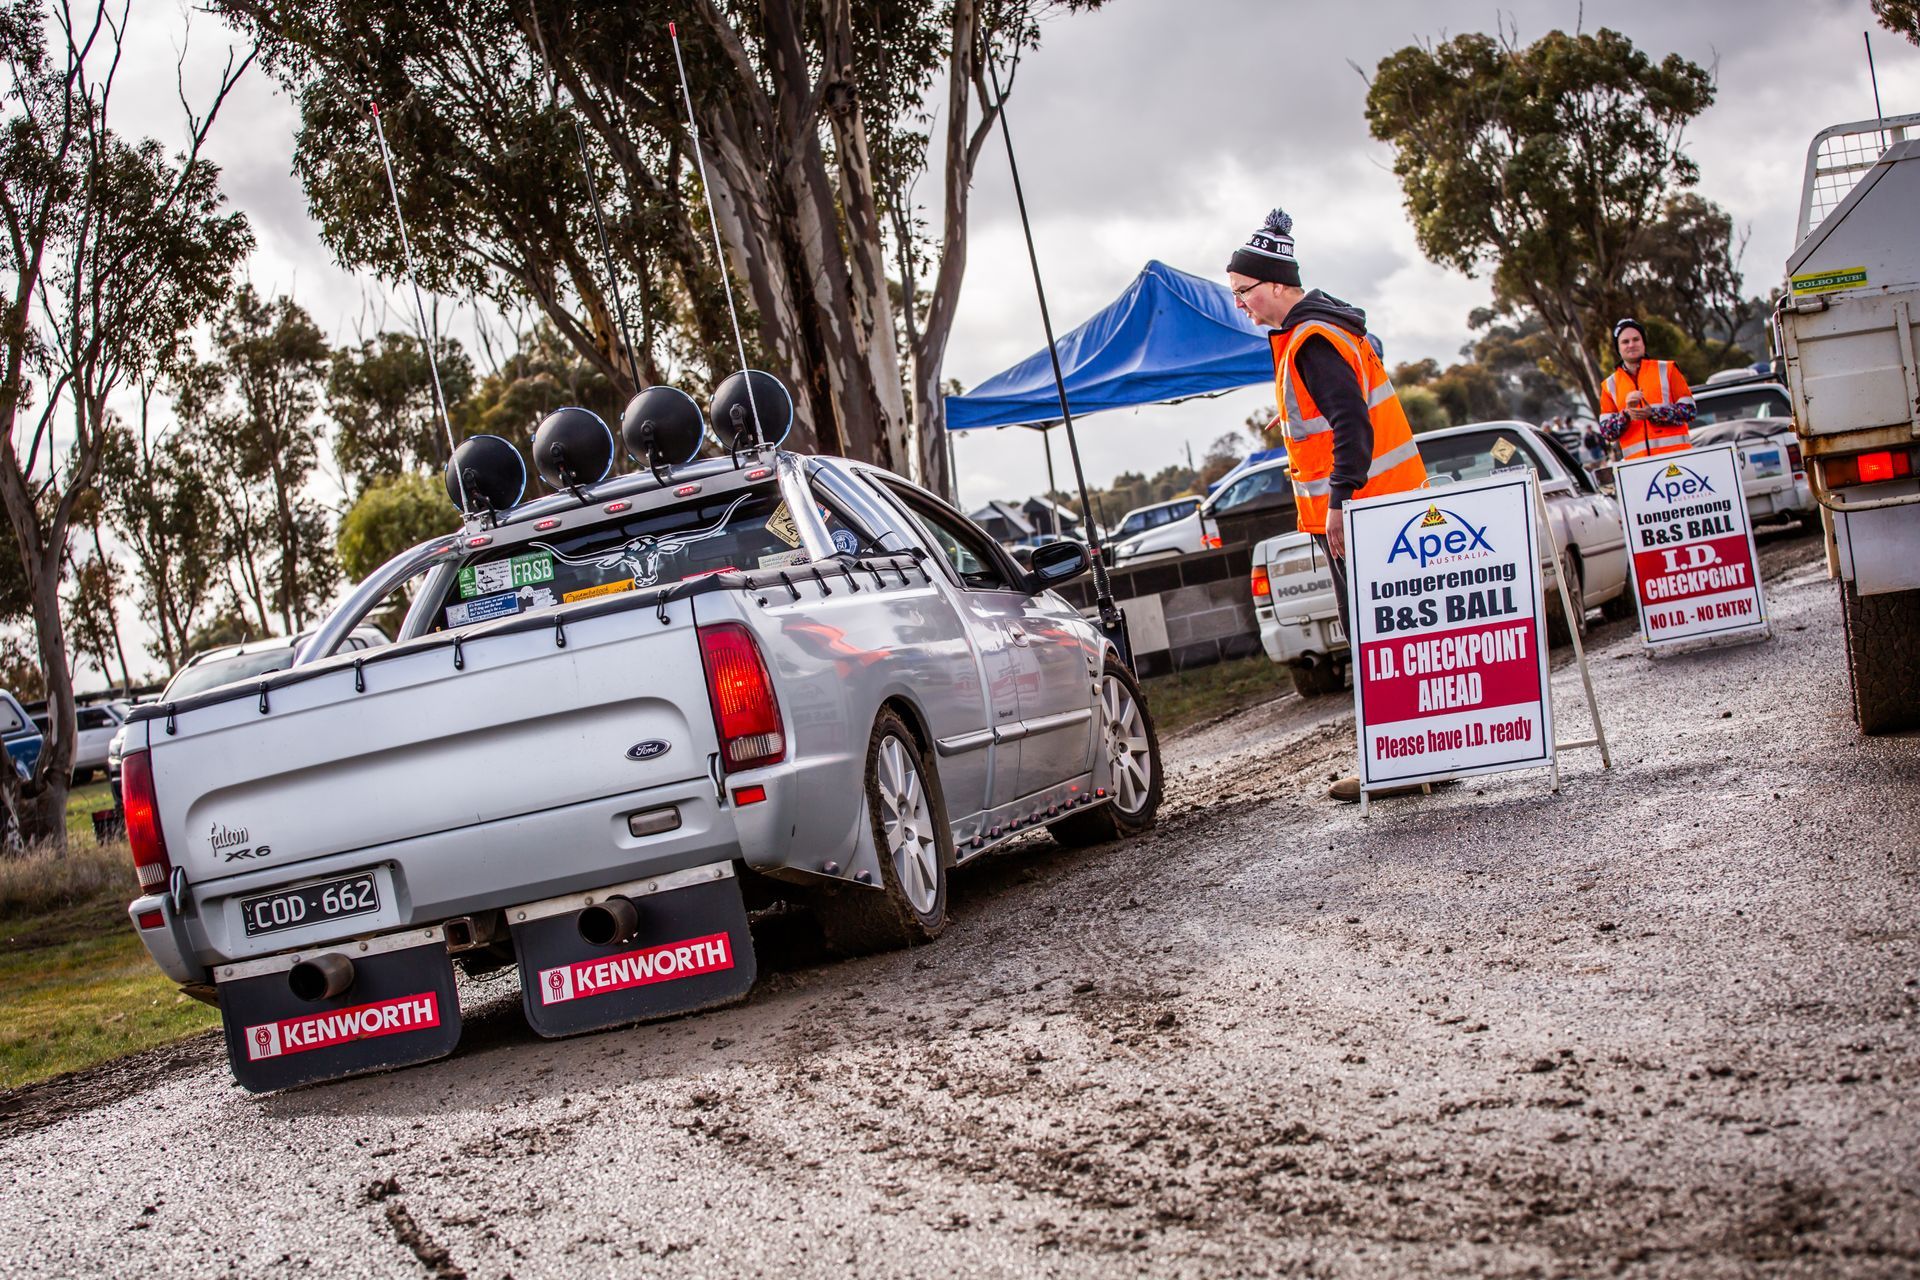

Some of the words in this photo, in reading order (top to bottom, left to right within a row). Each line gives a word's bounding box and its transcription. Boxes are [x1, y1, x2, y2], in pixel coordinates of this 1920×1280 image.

[1797, 278, 1833, 289] COLBO
[1646, 474, 1716, 504] Apex
[1636, 499, 1732, 526] Longerenong
[1387, 525, 1496, 568] Apex
[1641, 523, 1684, 547] B&S
[1687, 515, 1735, 538] BALL
[513, 558, 552, 584] FRSB
[1428, 551, 1489, 566] AUSTRALIA
[1661, 544, 1722, 573] I.D.
[1371, 563, 1516, 601] Longerenong
[1645, 563, 1746, 600] CHECKPOINT
[1374, 599, 1438, 634] B&S
[1446, 586, 1518, 623] BALL
[1650, 613, 1668, 630] NO
[1669, 610, 1689, 627] I.D.
[1696, 604, 1714, 622] NO
[1716, 598, 1753, 619] ENTRY
[1368, 647, 1400, 681] I.D.
[1403, 626, 1528, 677] CHECKPOINT
[1418, 672, 1483, 713] AHEAD
[636, 743, 658, 756] Ford
[1376, 730, 1425, 760] Please
[1428, 725, 1463, 754] have
[1465, 722, 1488, 749] I.D.
[1490, 716, 1532, 745] ready
[224, 845, 272, 862] XR6
[576, 938, 726, 991] KENWORTH
[284, 999, 433, 1049] KENWORTH
